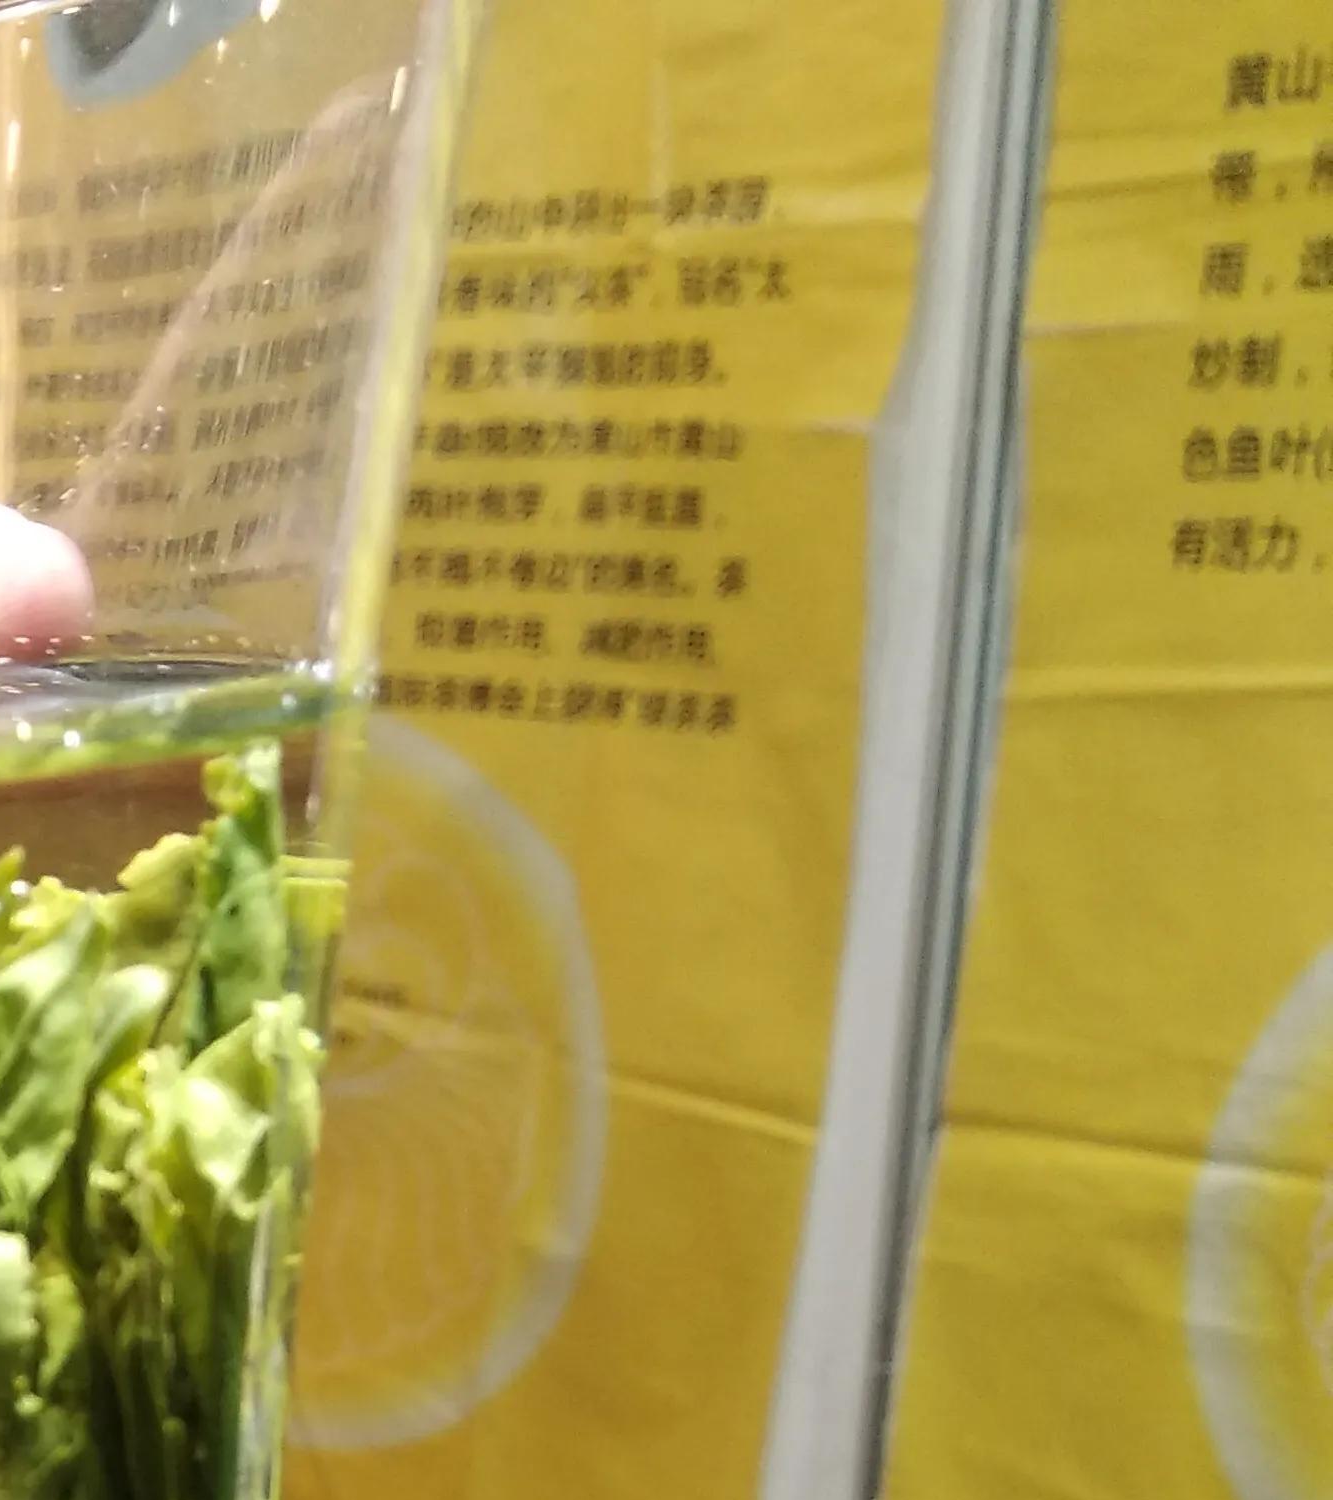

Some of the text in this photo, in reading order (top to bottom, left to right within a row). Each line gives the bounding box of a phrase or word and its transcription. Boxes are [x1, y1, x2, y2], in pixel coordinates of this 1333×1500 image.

[1226, 46, 1333, 109] 黄山
[1190, 333, 1333, 388] 炒制,
[1181, 422, 1333, 483] 色鱼叶(
